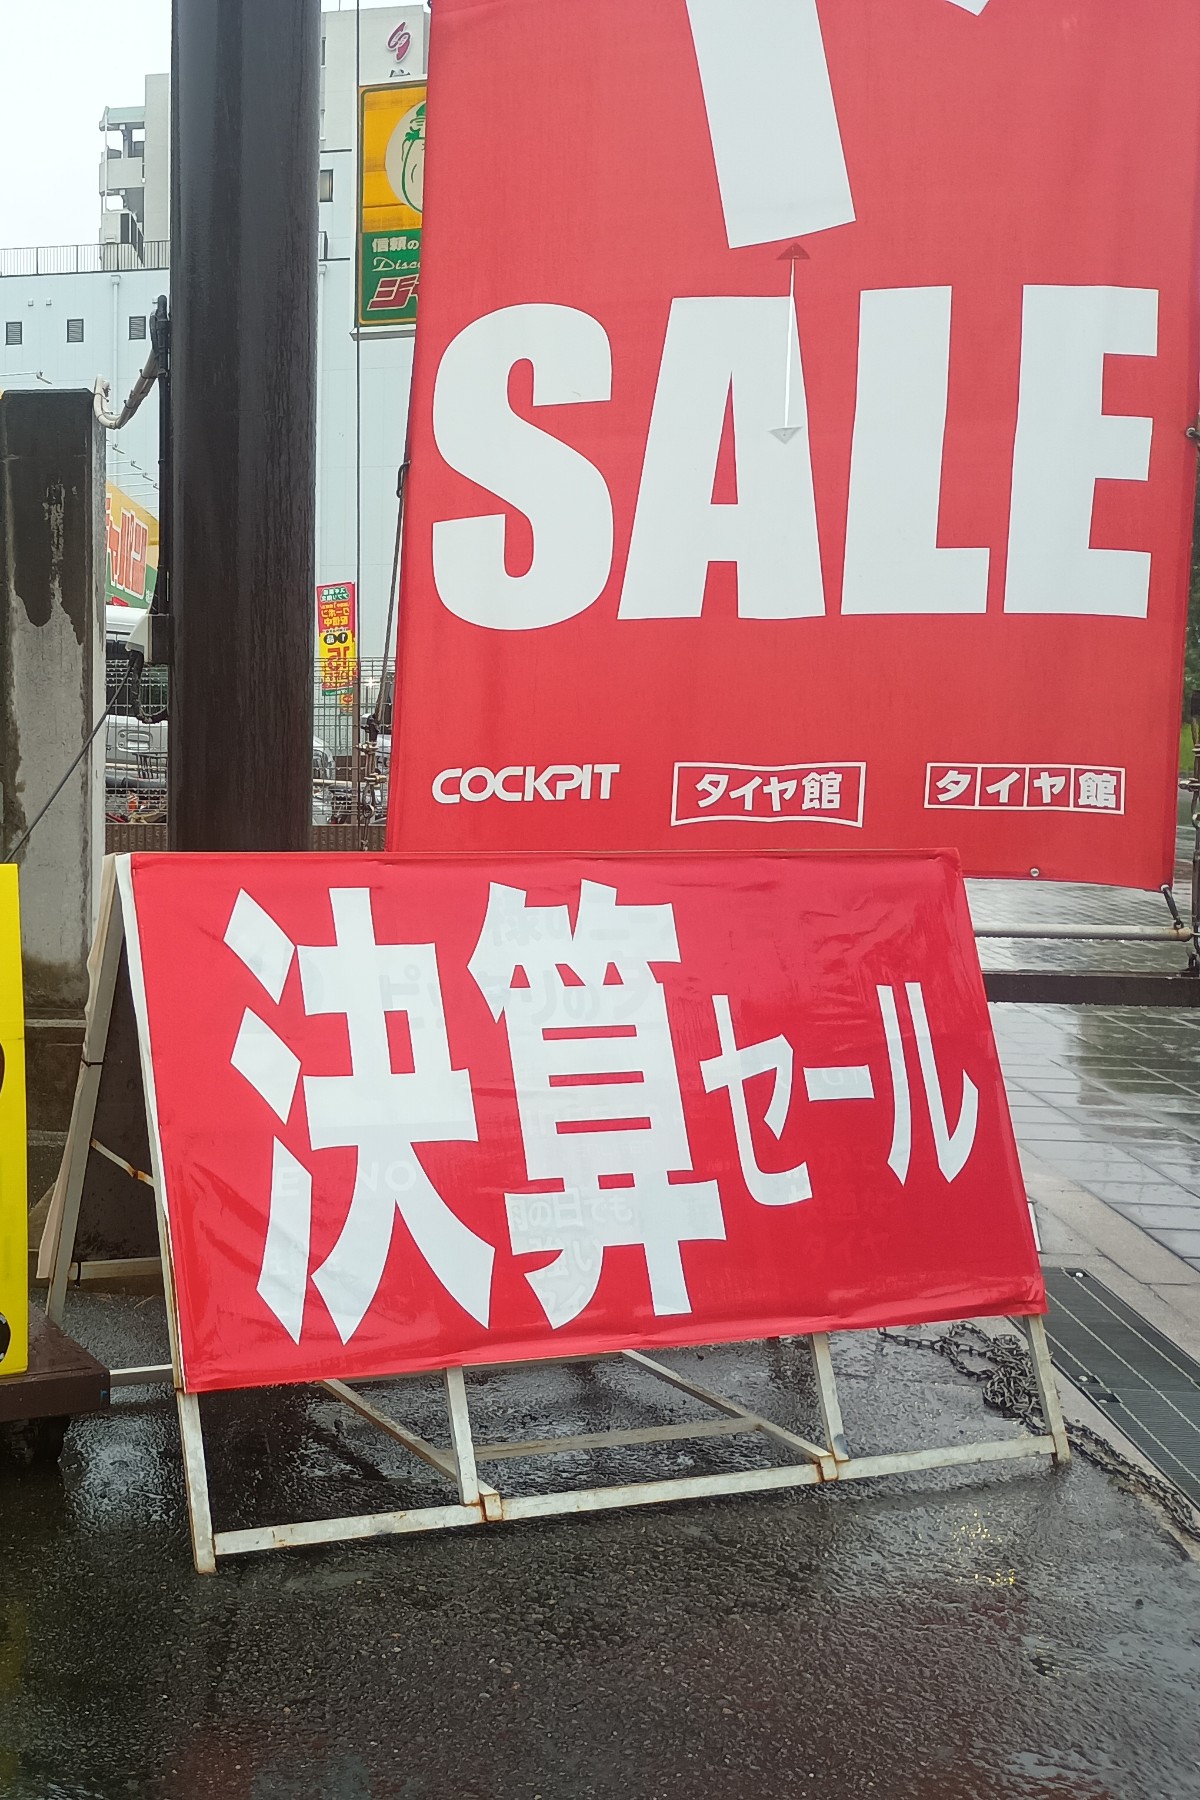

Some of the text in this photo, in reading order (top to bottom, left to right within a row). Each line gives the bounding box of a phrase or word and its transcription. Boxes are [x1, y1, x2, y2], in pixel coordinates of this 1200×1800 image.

[372, 236, 421, 253] 信頼の
[432, 282, 1160, 632] SALE
[431, 763, 620, 804] COCKPIT
[696, 772, 842, 811] タイヤ館
[935, 770, 1117, 809] タイヤ館
[223, 878, 978, 1345] 決算セール
